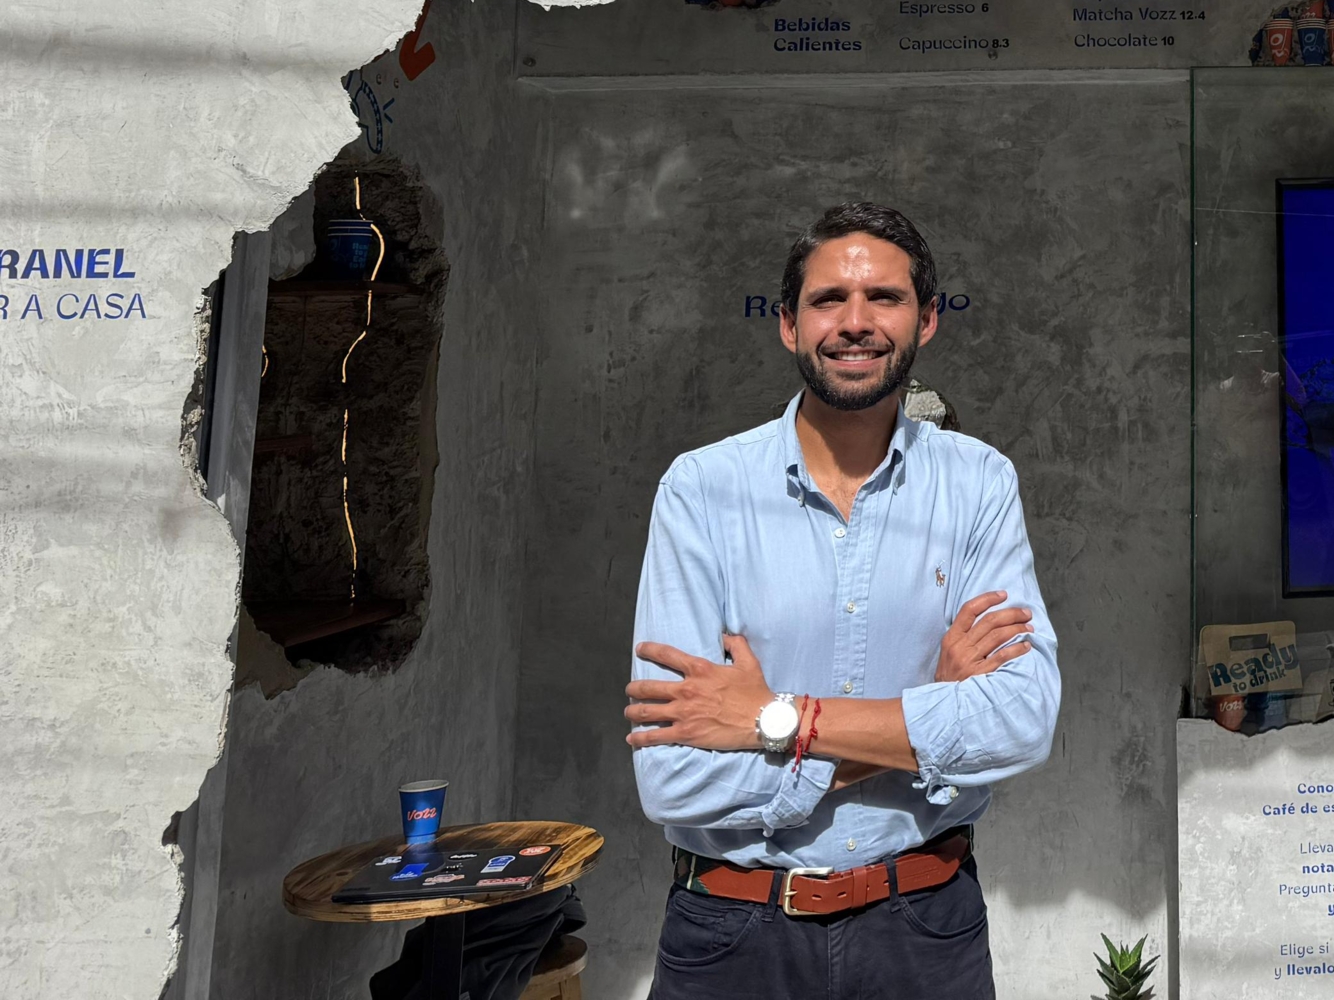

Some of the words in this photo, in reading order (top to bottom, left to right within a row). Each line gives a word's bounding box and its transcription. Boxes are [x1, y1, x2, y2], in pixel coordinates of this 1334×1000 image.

[900, 1, 975, 18] Espresso
[982, 3, 989, 13] 6
[1073, 7, 1133, 21] Matcha
[1139, 7, 1177, 20] Vozz
[1180, 11, 1206, 20] 12.4
[774, 18, 851, 32] Bebidas
[773, 37, 862, 51] Calientes
[900, 36, 989, 54] Capuccino
[992, 39, 1010, 48] 8.3
[1074, 34, 1158, 48] Chocolate
[1161, 36, 1174, 46] 10
[0, 248, 136, 279] RANEL
[20, 294, 43, 319] A
[56, 293, 147, 319] CASA
[1208, 643, 1299, 687] Ready
[1233, 682, 1247, 693] to
[1250, 666, 1286, 688] drink
[1262, 803, 1296, 816] Café
[1300, 802, 1318, 814] de
[1300, 842, 1334, 854] Lleva
[1280, 943, 1314, 958] Elige
[1319, 942, 1329, 954] si
[1274, 967, 1282, 979] y
